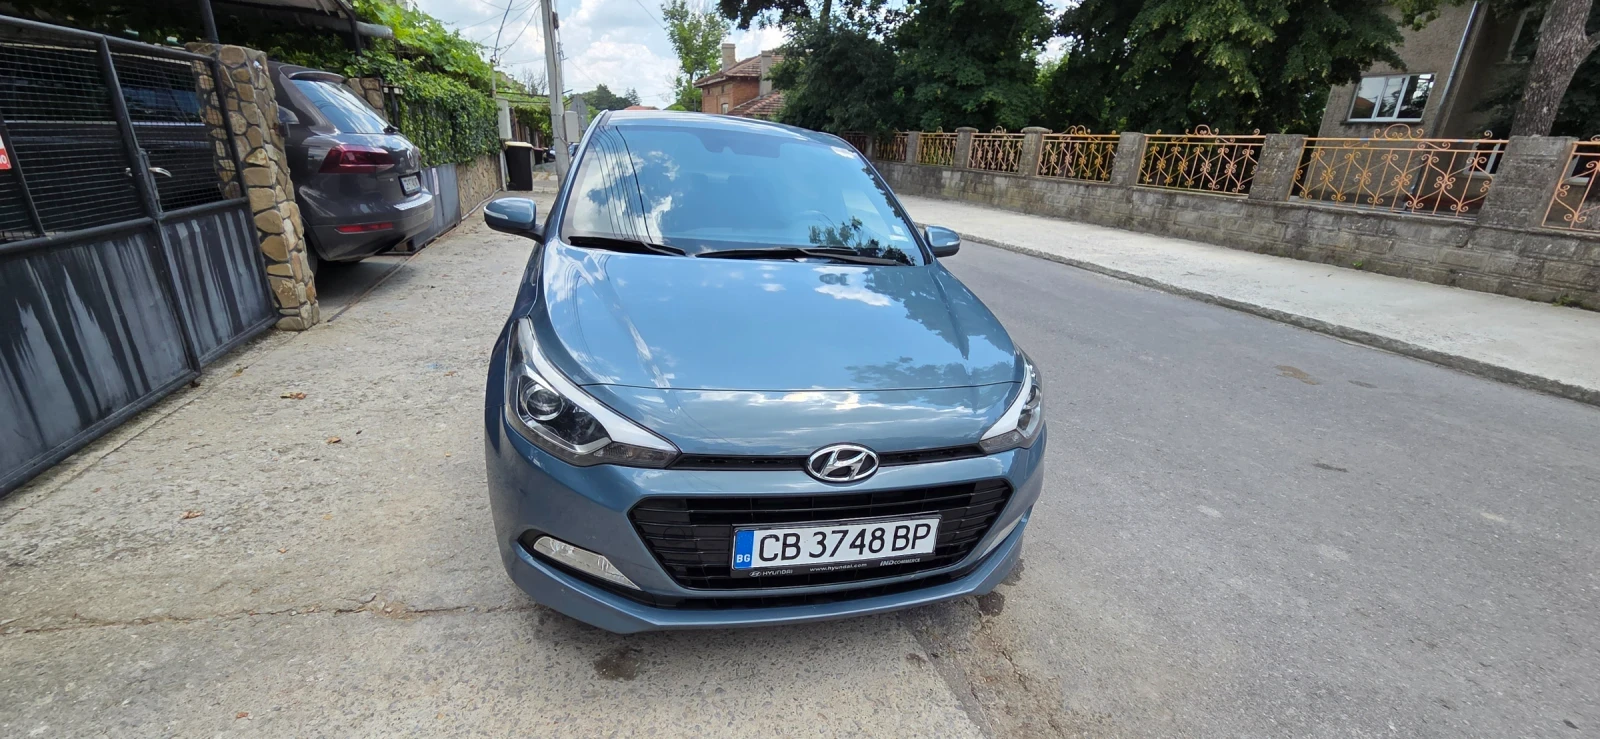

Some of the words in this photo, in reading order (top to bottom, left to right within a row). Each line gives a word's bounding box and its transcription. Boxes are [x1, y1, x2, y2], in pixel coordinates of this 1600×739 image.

[759, 533, 801, 562] CB
[808, 527, 886, 558] 3748
[891, 523, 932, 552] BP
[736, 554, 751, 563] BG
[809, 563, 868, 572] www.hyundai.com
